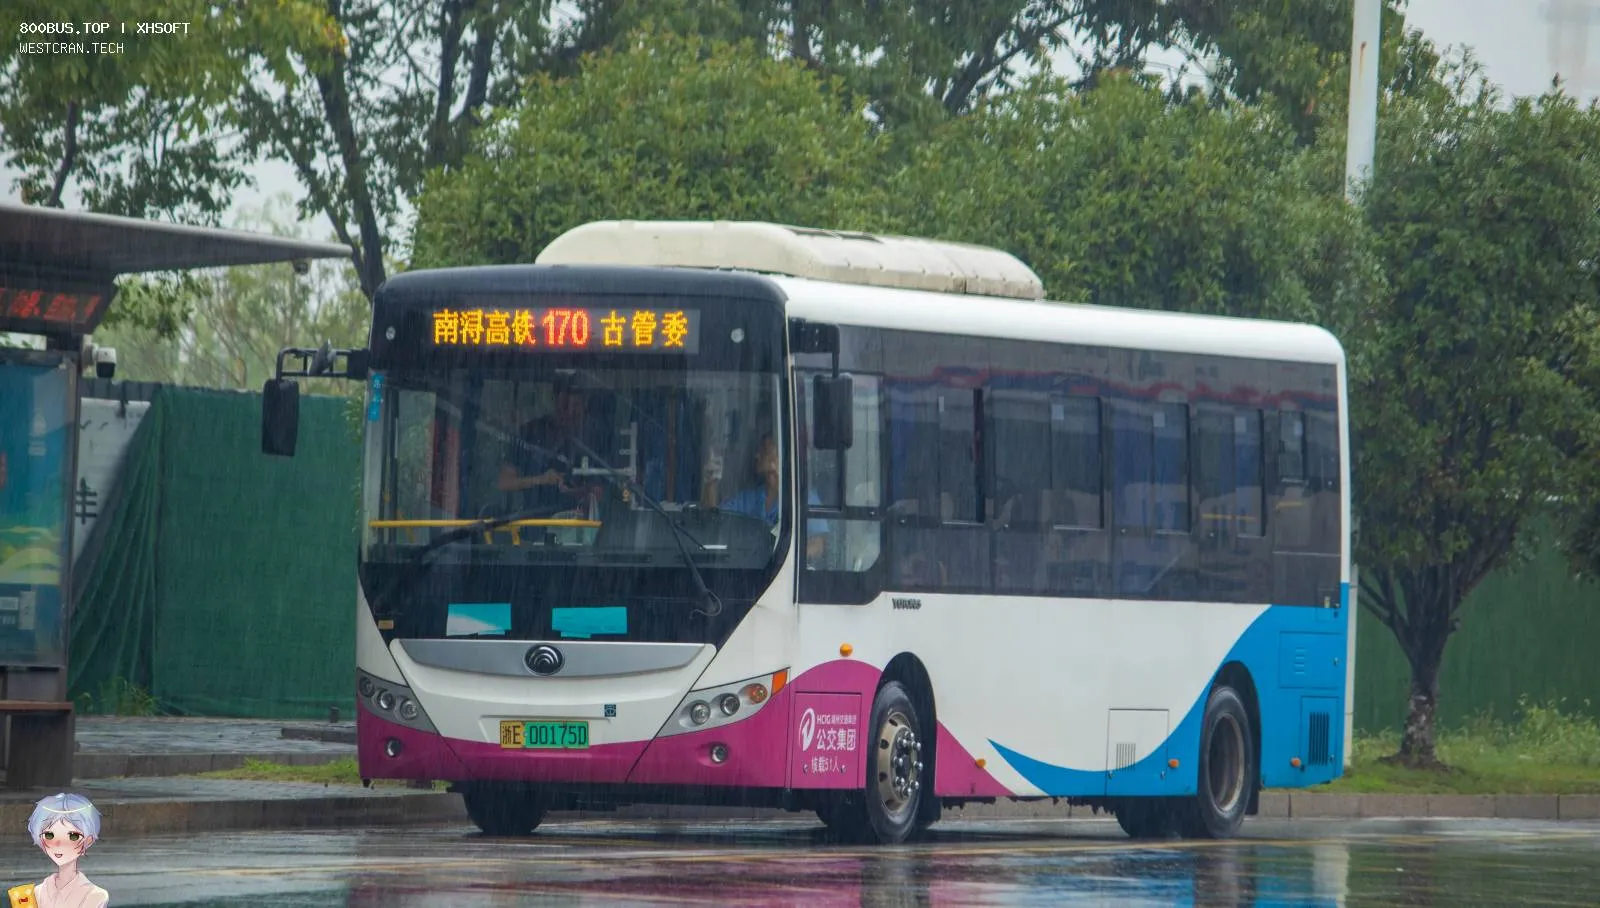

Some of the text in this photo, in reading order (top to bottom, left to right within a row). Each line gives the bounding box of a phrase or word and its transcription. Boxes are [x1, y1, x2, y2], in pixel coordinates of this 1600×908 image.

[433, 309, 688, 346] 南浔高铁 170 古管委
[816, 727, 857, 752] 公交集团
